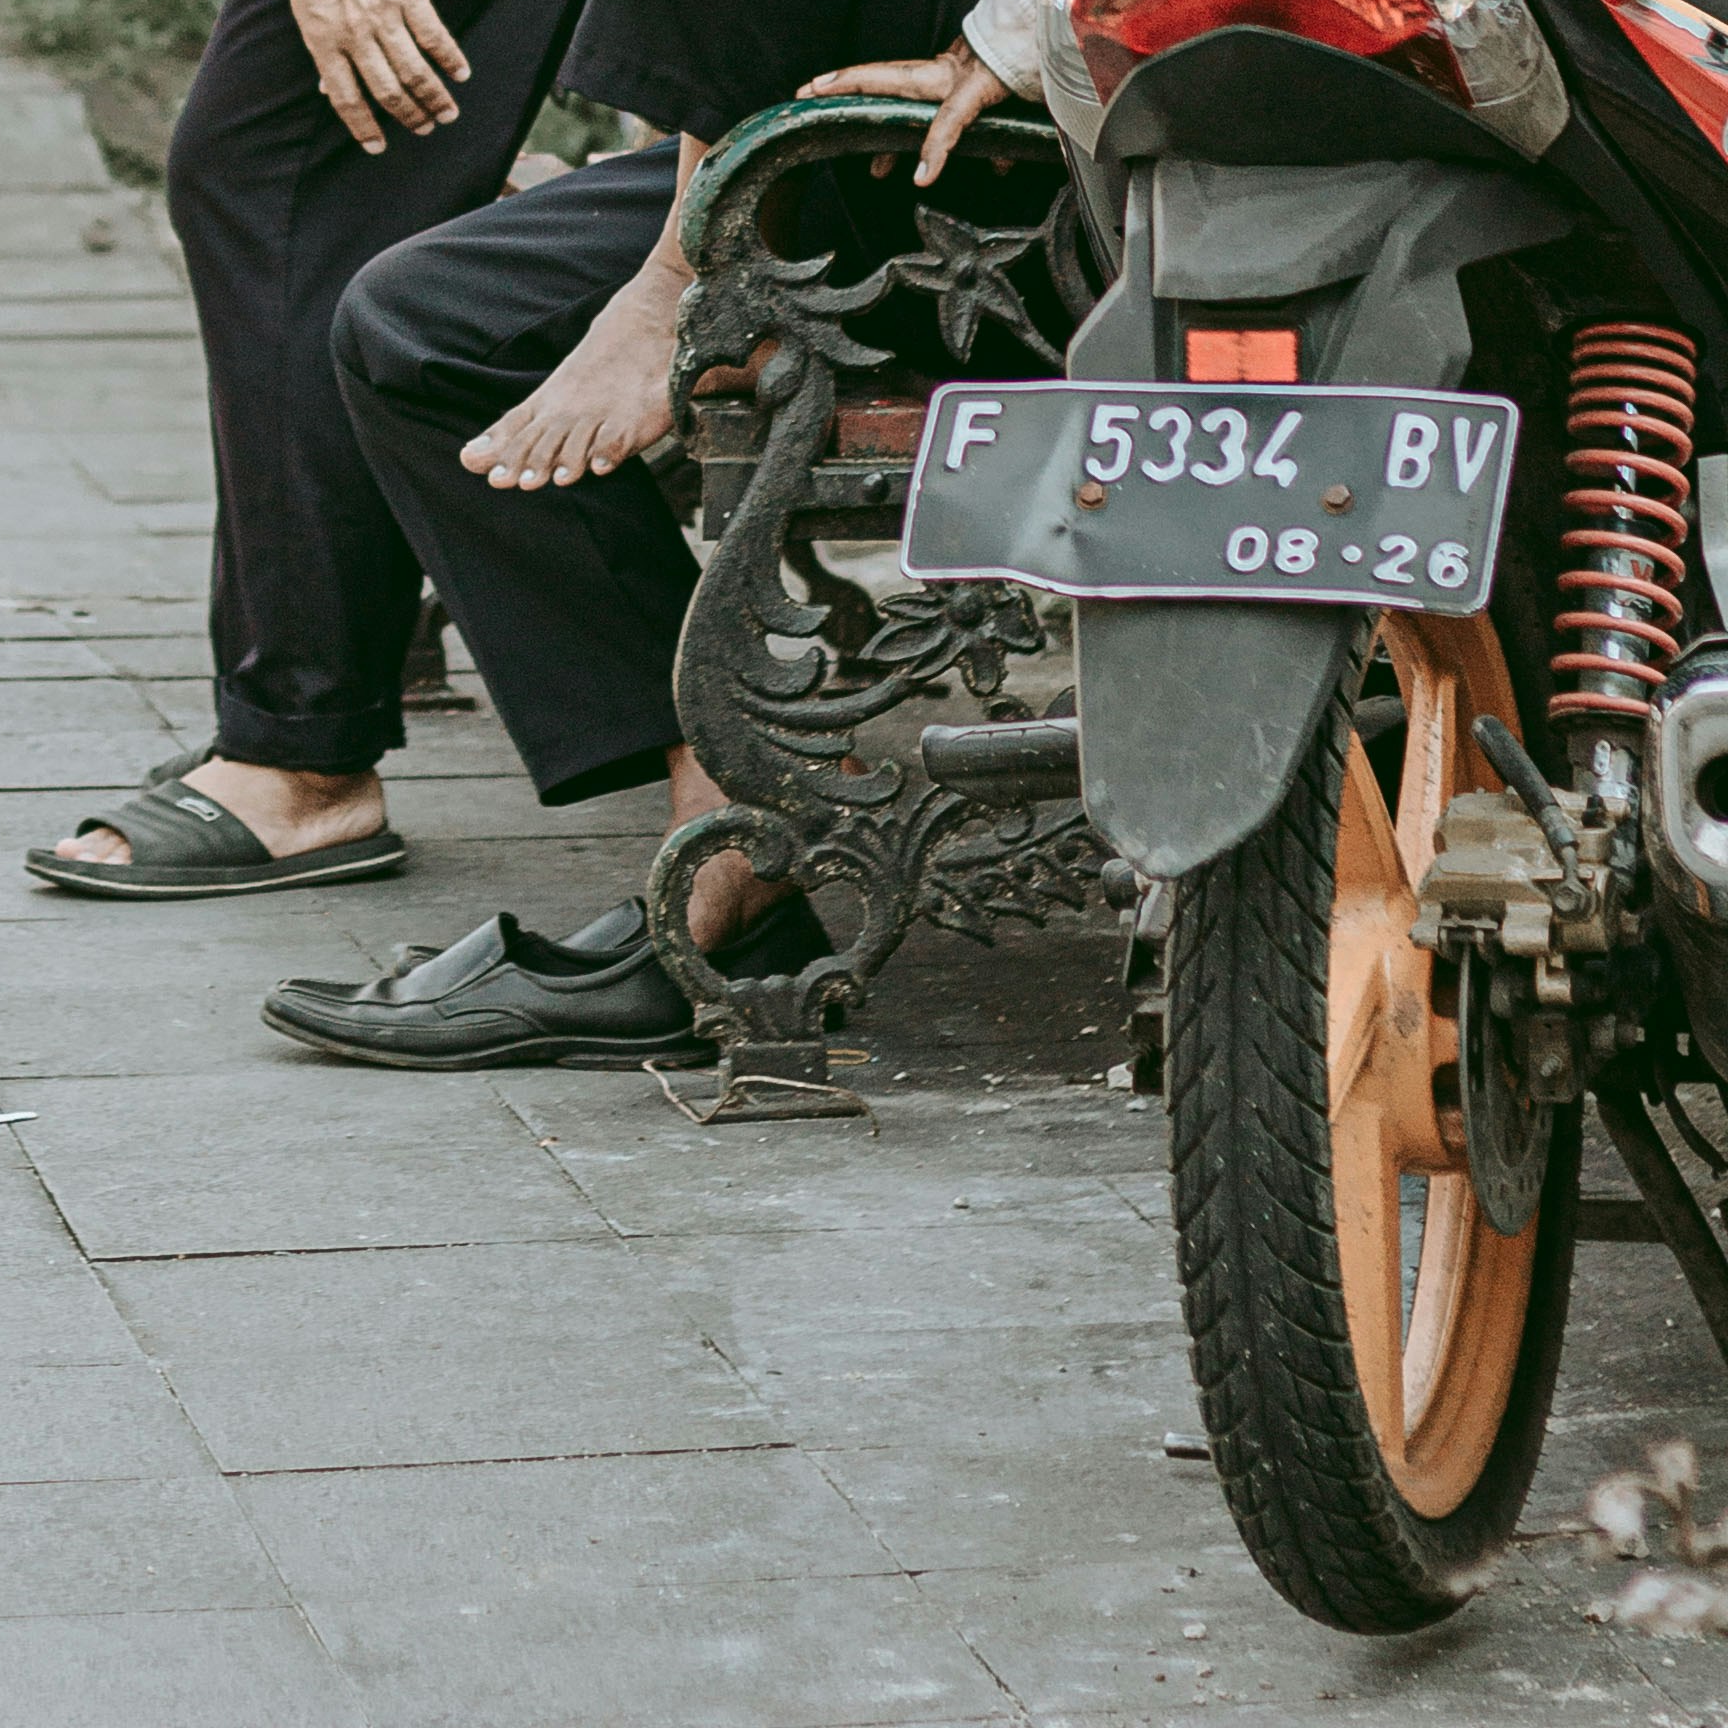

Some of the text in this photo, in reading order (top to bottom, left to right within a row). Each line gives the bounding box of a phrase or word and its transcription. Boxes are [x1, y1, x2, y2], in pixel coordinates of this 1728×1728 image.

[945, 400, 1500, 494] F 5334 BV
